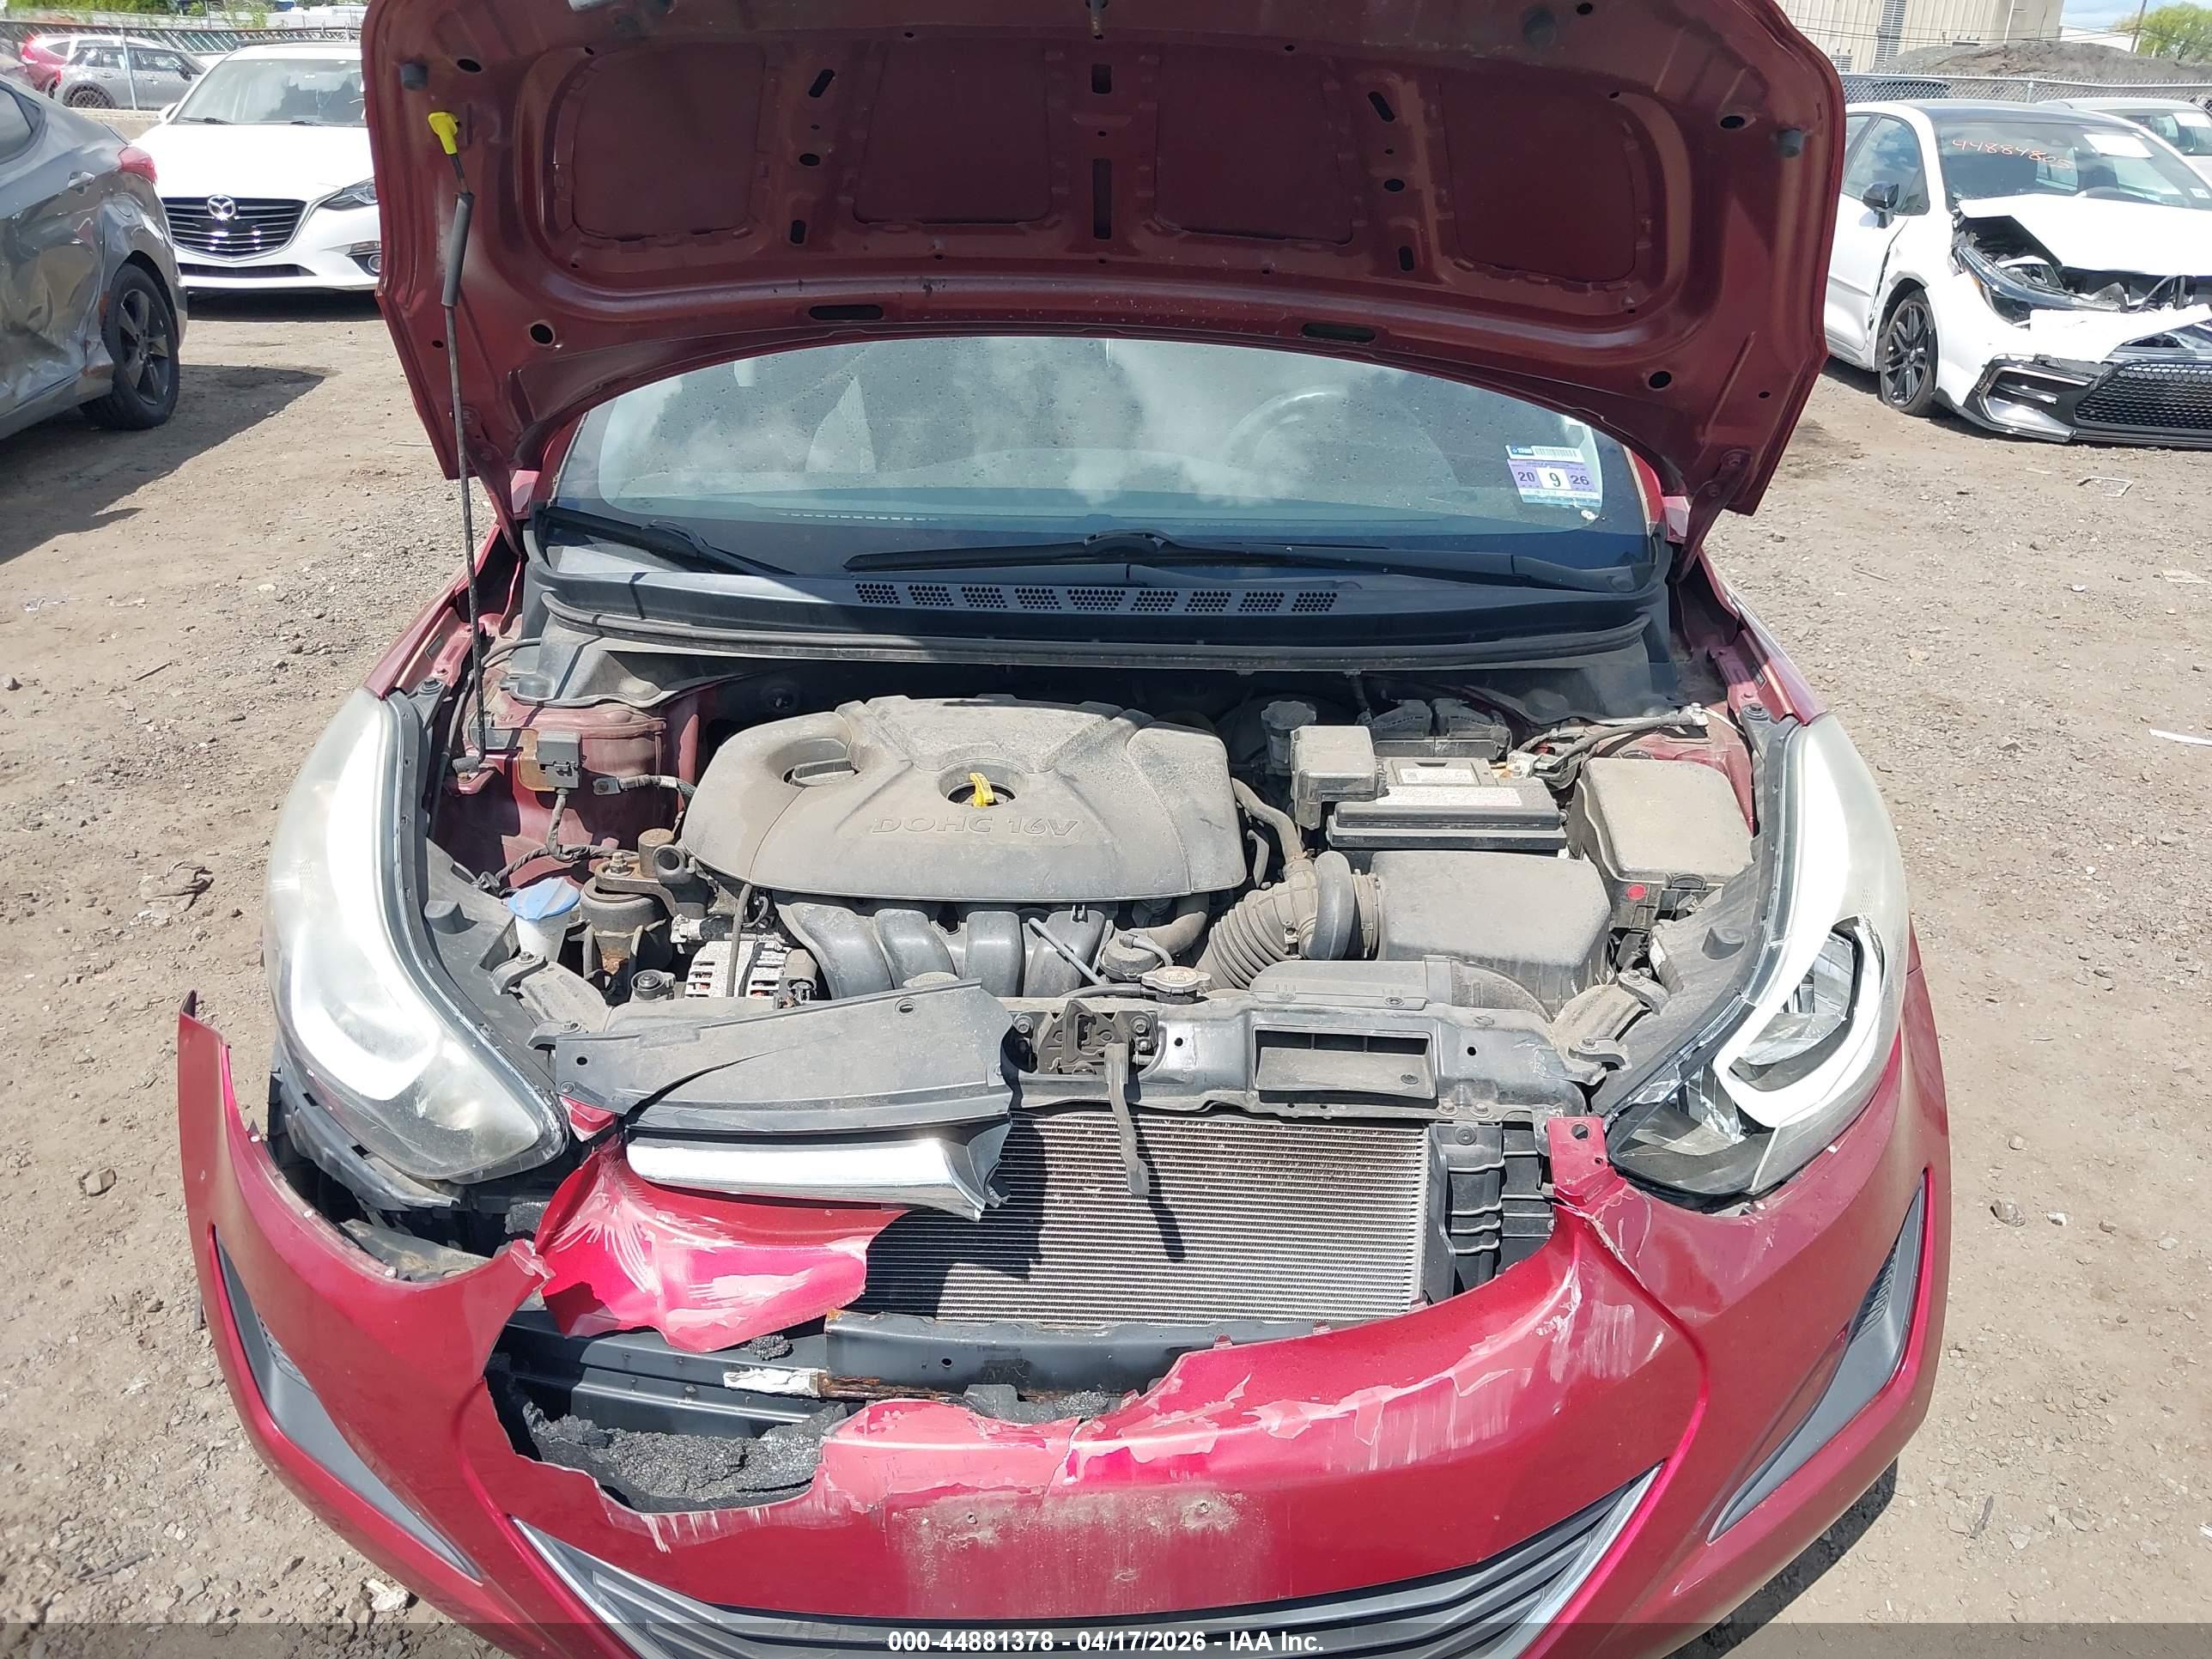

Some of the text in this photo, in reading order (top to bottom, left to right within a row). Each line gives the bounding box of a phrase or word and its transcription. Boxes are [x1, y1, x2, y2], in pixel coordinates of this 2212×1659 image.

[1517, 471, 1589, 488] 20 9 26
[872, 817, 1079, 836] DOHC 16V
